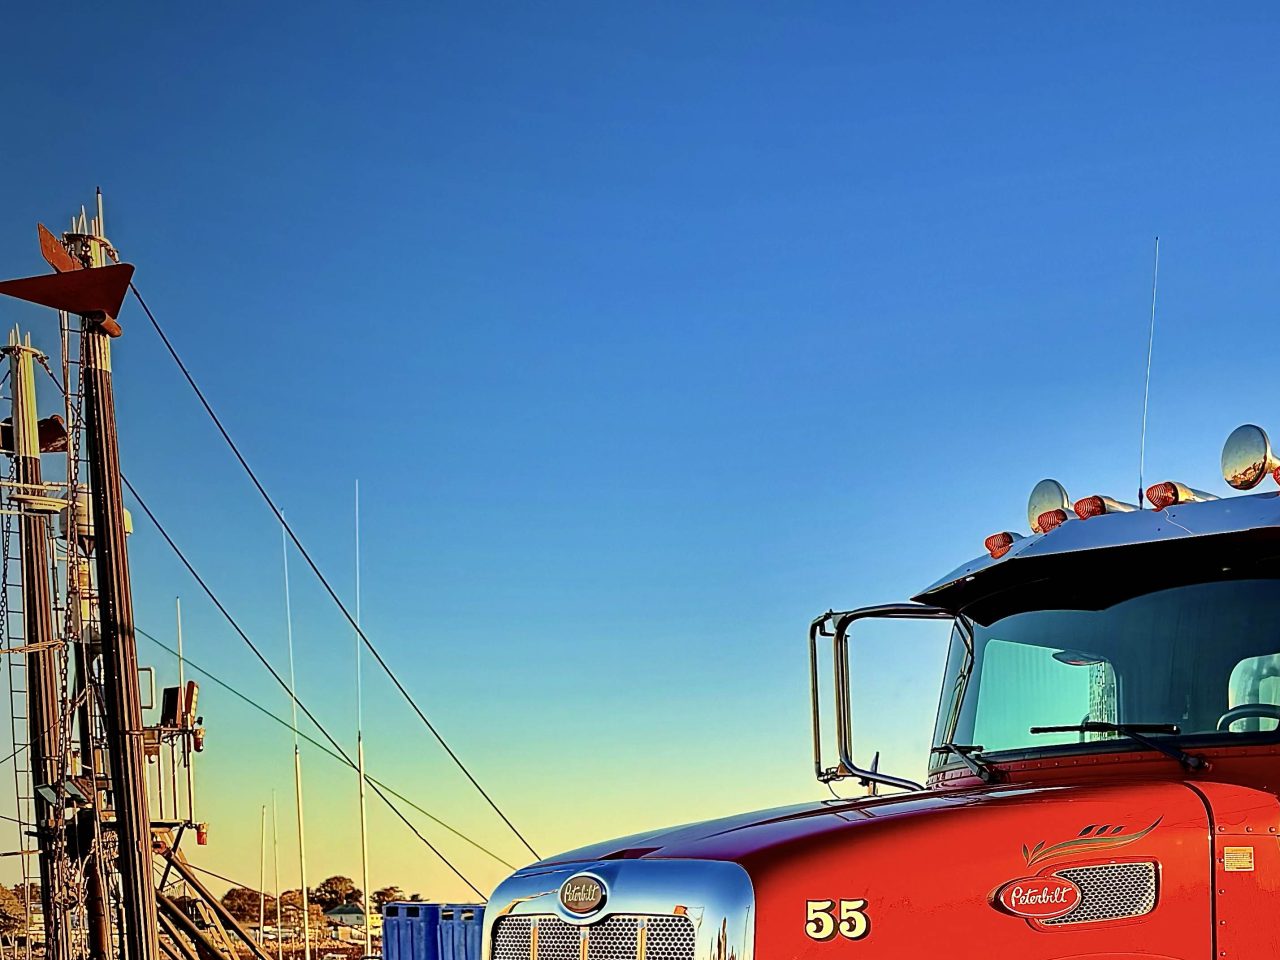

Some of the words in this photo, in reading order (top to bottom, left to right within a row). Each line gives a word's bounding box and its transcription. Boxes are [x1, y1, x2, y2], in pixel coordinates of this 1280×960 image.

[563, 882, 600, 904] Peterbilt
[1011, 886, 1073, 907] Peterbilt
[804, 898, 872, 942] 55
